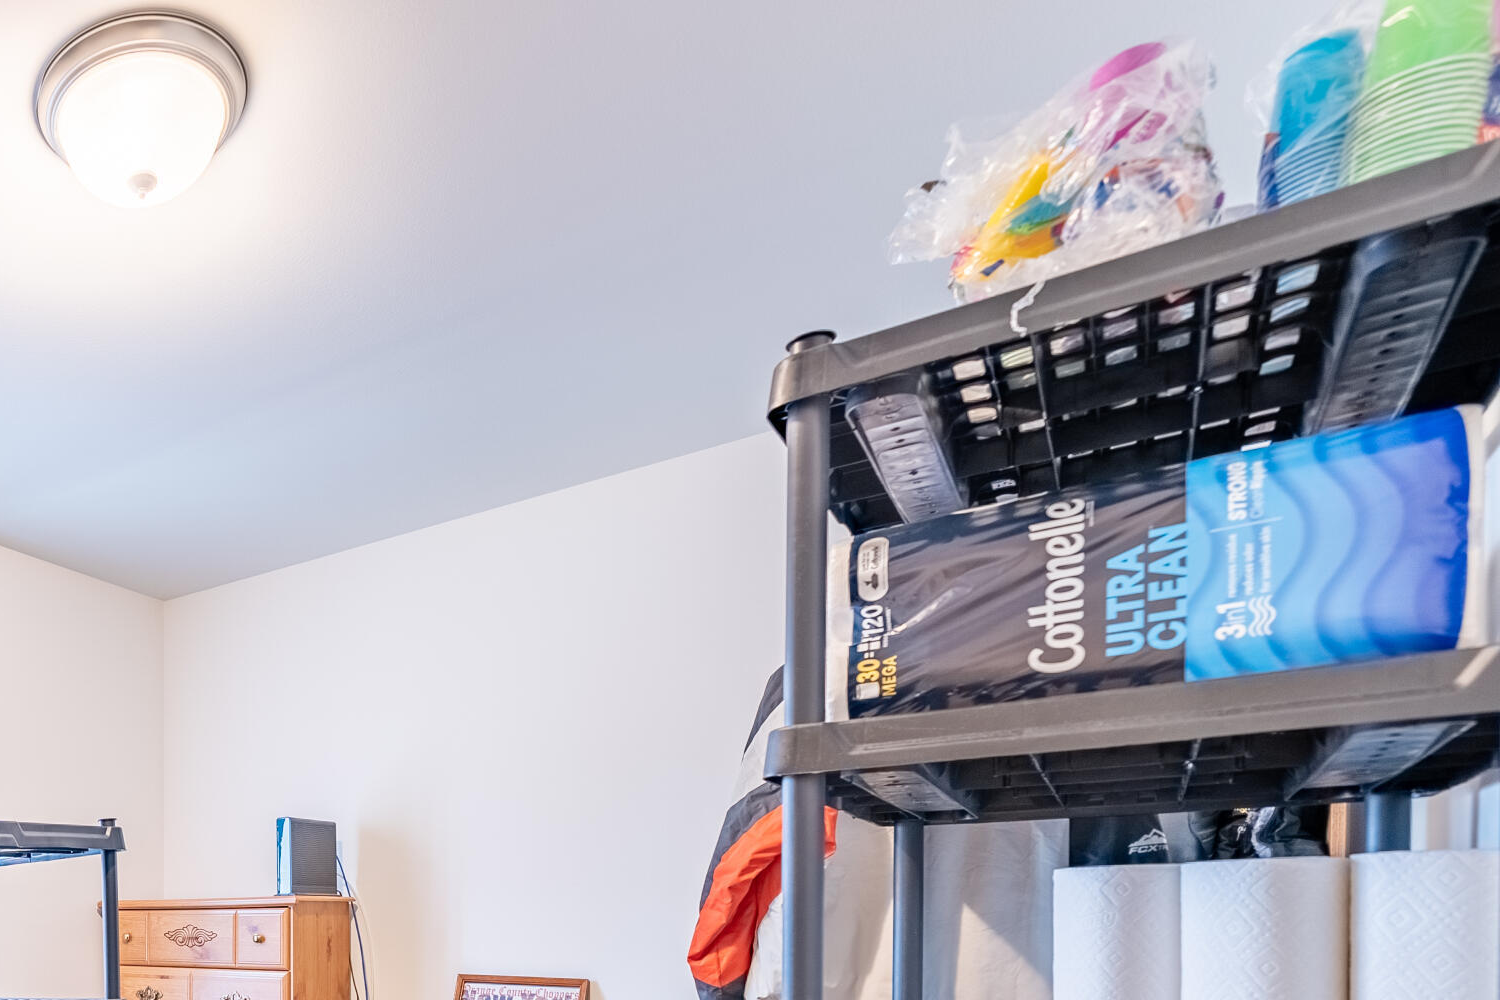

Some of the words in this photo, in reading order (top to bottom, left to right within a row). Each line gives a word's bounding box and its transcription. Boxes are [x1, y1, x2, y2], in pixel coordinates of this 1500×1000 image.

[1227, 462, 1247, 521] STRONG
[1026, 498, 1086, 674] Cottonelle
[1105, 544, 1146, 657] ULTRA
[1147, 523, 1188, 650] CLEAN
[880, 656, 897, 696] MEGA
[499, 986, 532, 998] County
[535, 987, 580, 1000] Choppers
